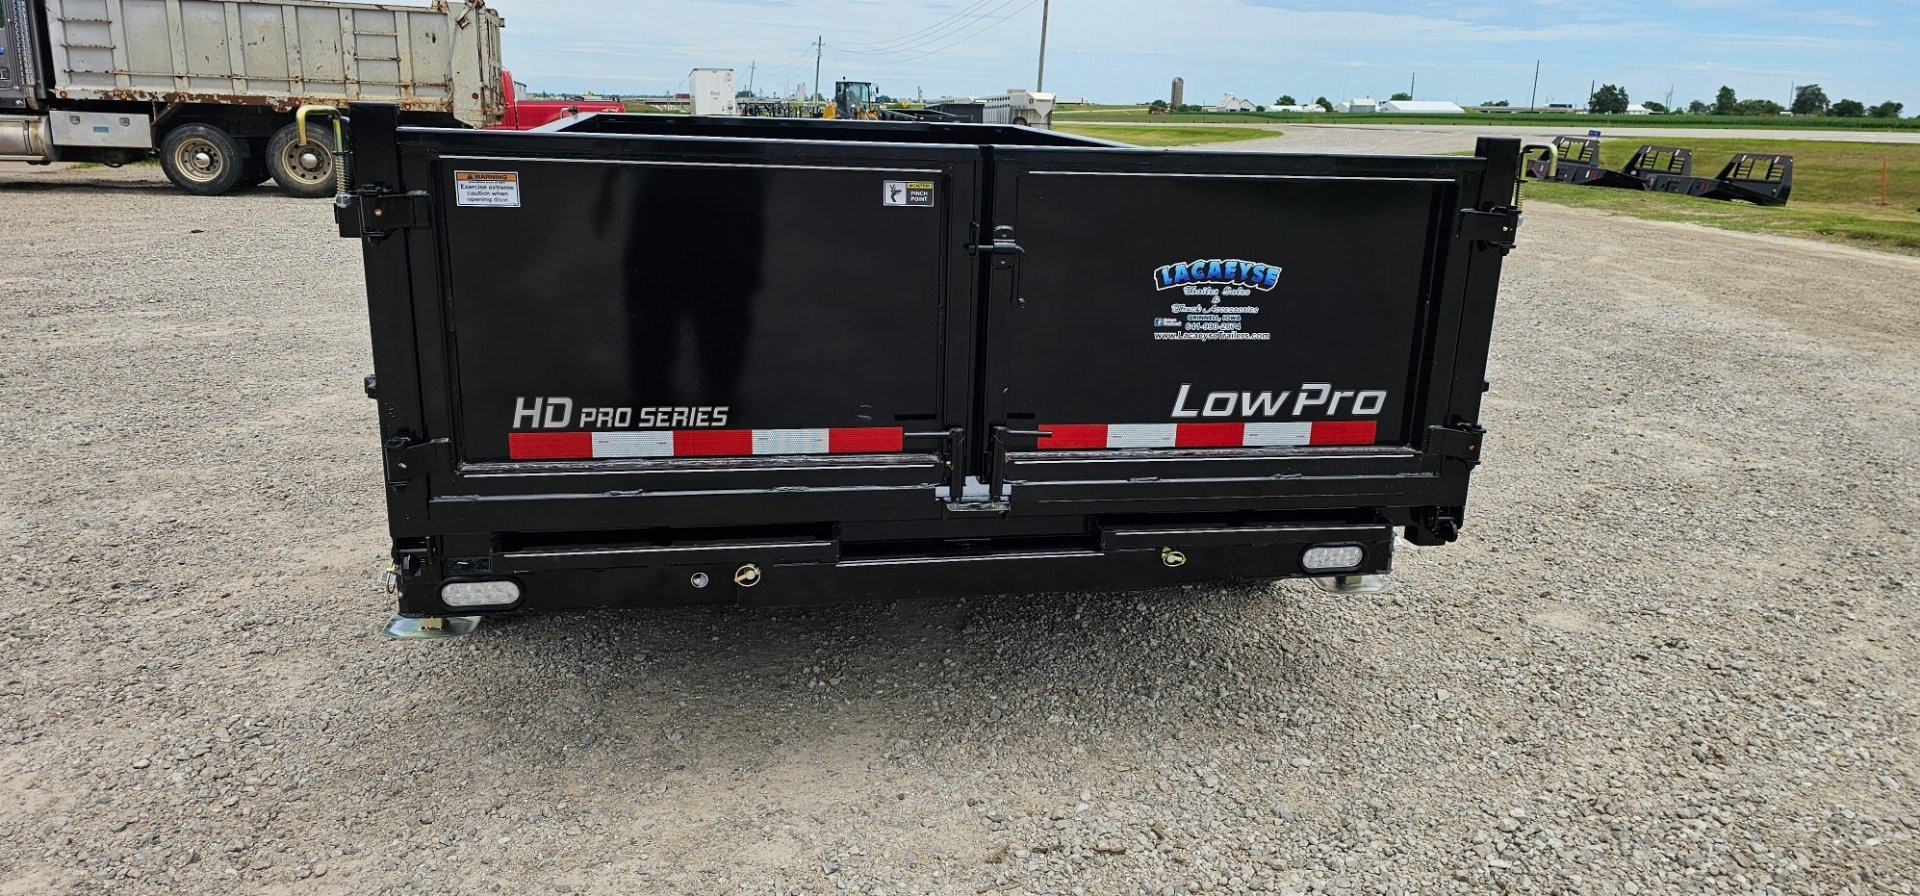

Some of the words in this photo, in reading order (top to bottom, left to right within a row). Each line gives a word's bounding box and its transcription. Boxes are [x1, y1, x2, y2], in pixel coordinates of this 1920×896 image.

[1156, 260, 1282, 289] LACAEYSE
[1170, 303, 1202, 314] Truck
[1222, 314, 1242, 322] IOWA
[1154, 330, 1271, 342] www.LacaeyseTrailers.com
[512, 396, 573, 429] HD
[579, 407, 632, 428] PRO
[638, 405, 729, 427] SERIES
